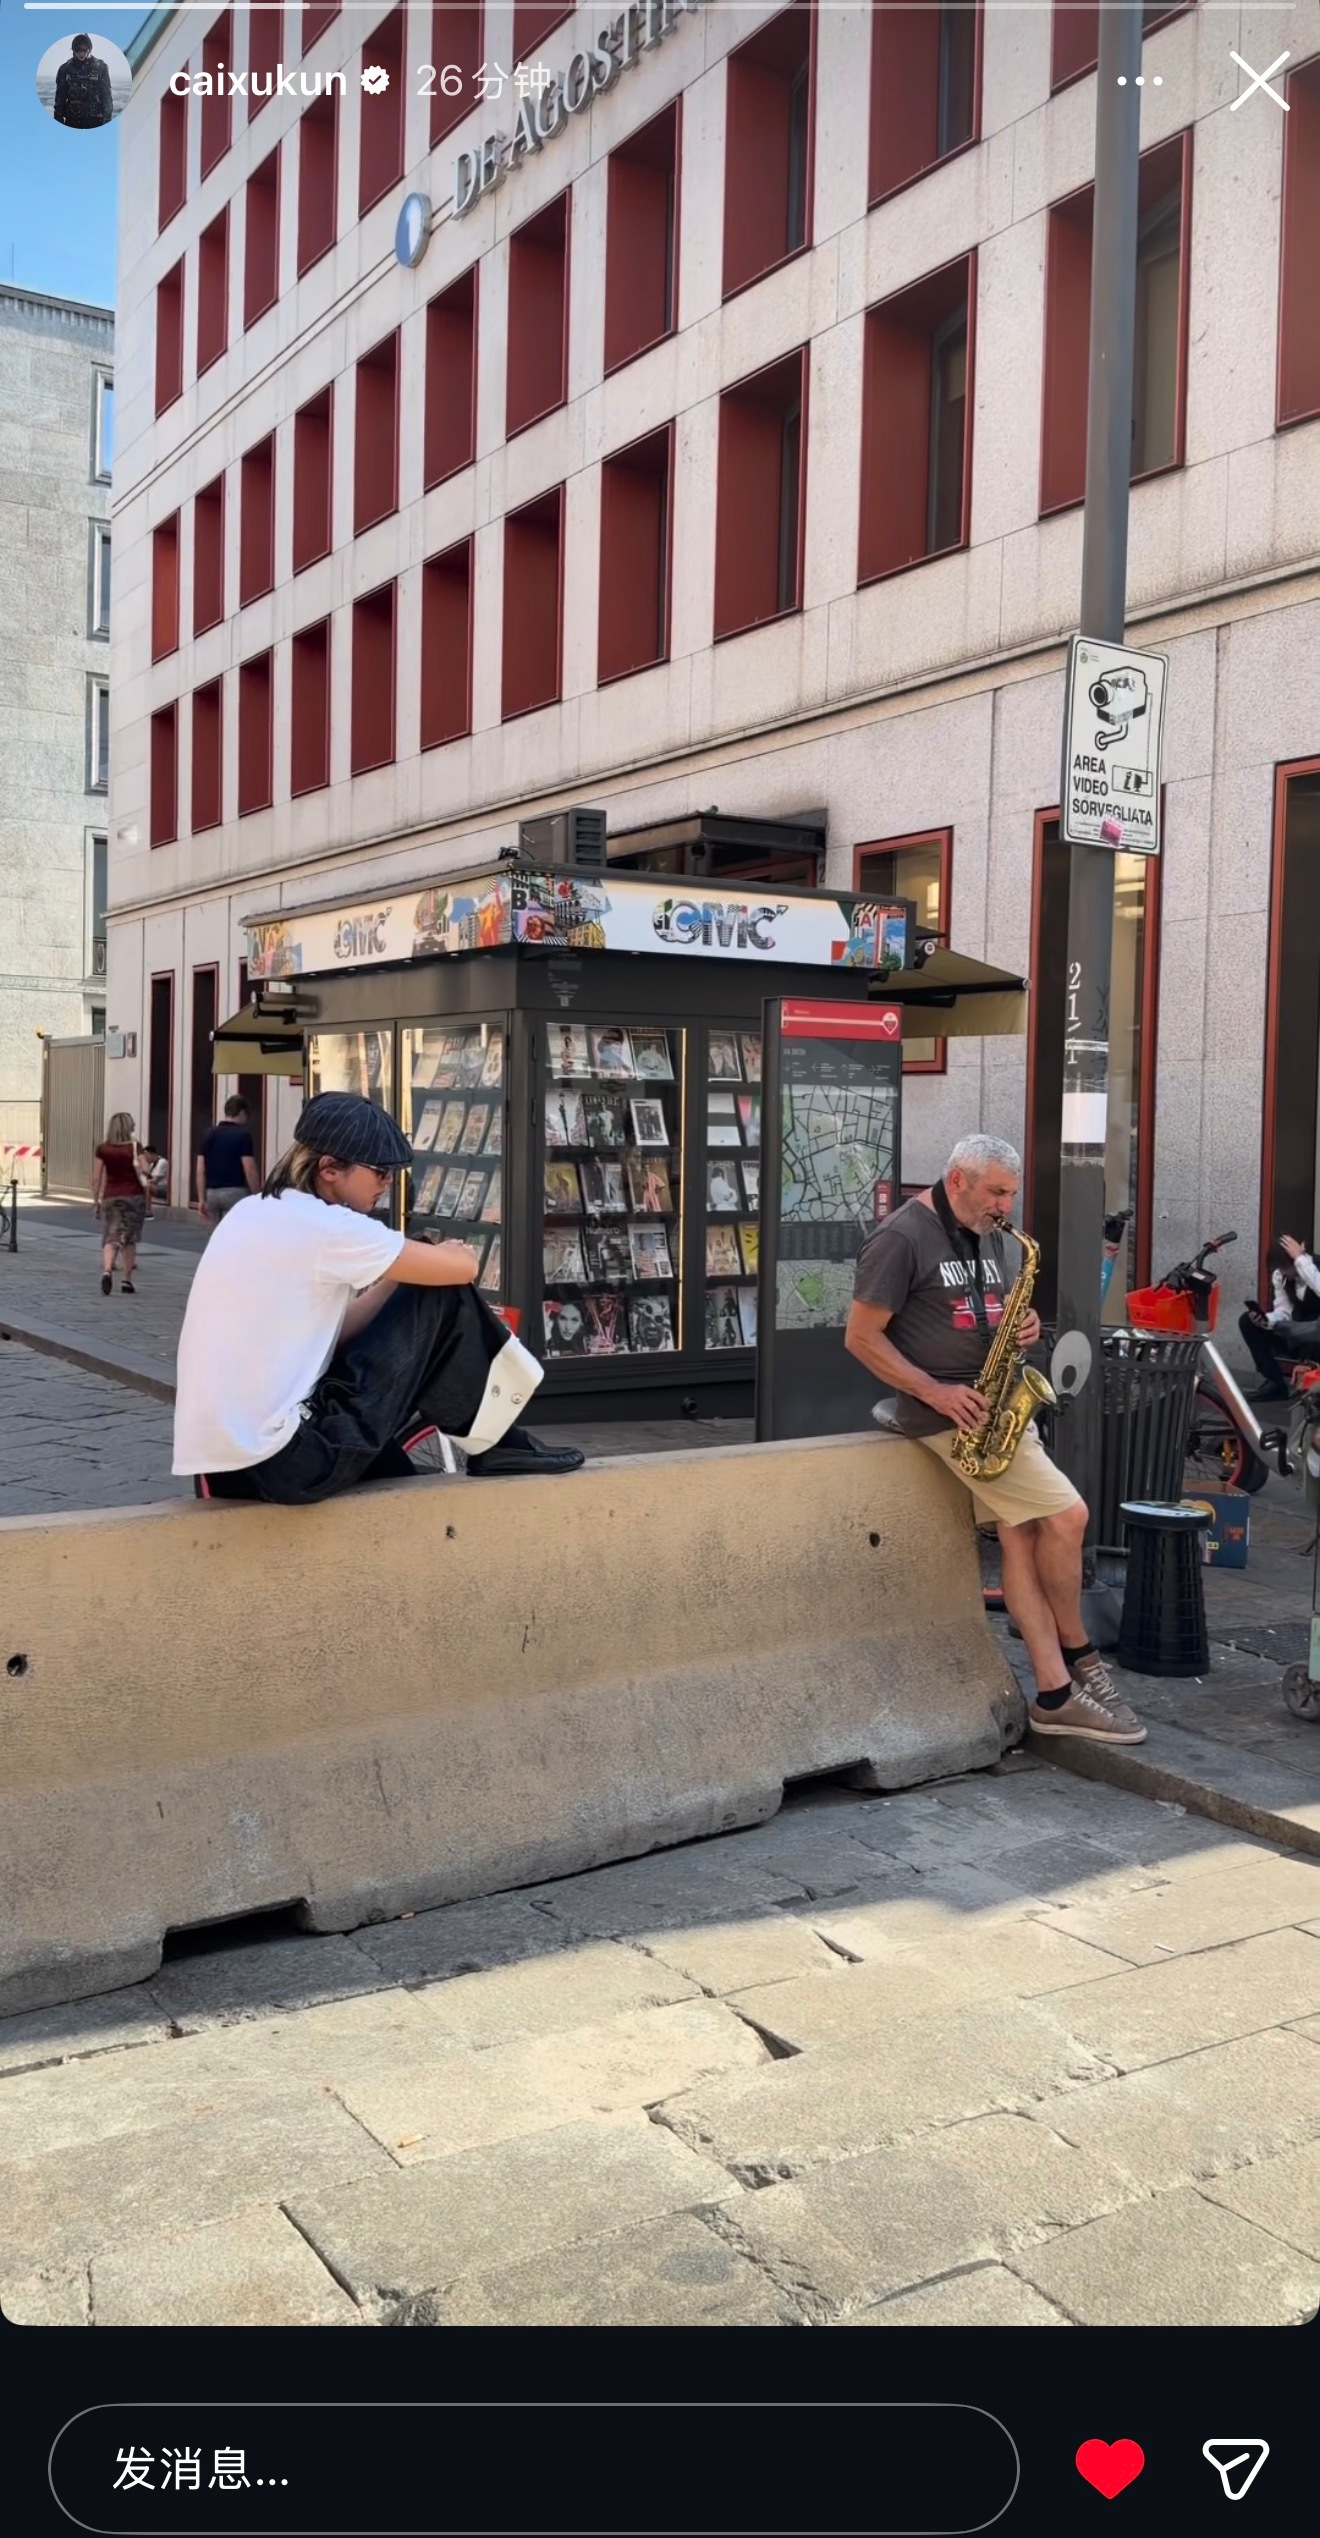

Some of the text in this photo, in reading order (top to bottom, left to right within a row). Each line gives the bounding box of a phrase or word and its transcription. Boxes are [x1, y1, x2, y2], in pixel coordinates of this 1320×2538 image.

[451, 133, 506, 221] DE
[1073, 754, 1106, 774] AREA
[1073, 776, 1109, 796] VIDEO
[1072, 798, 1153, 826] SORVEGLIATA
[939, 1259, 1002, 1288] NOWAY
